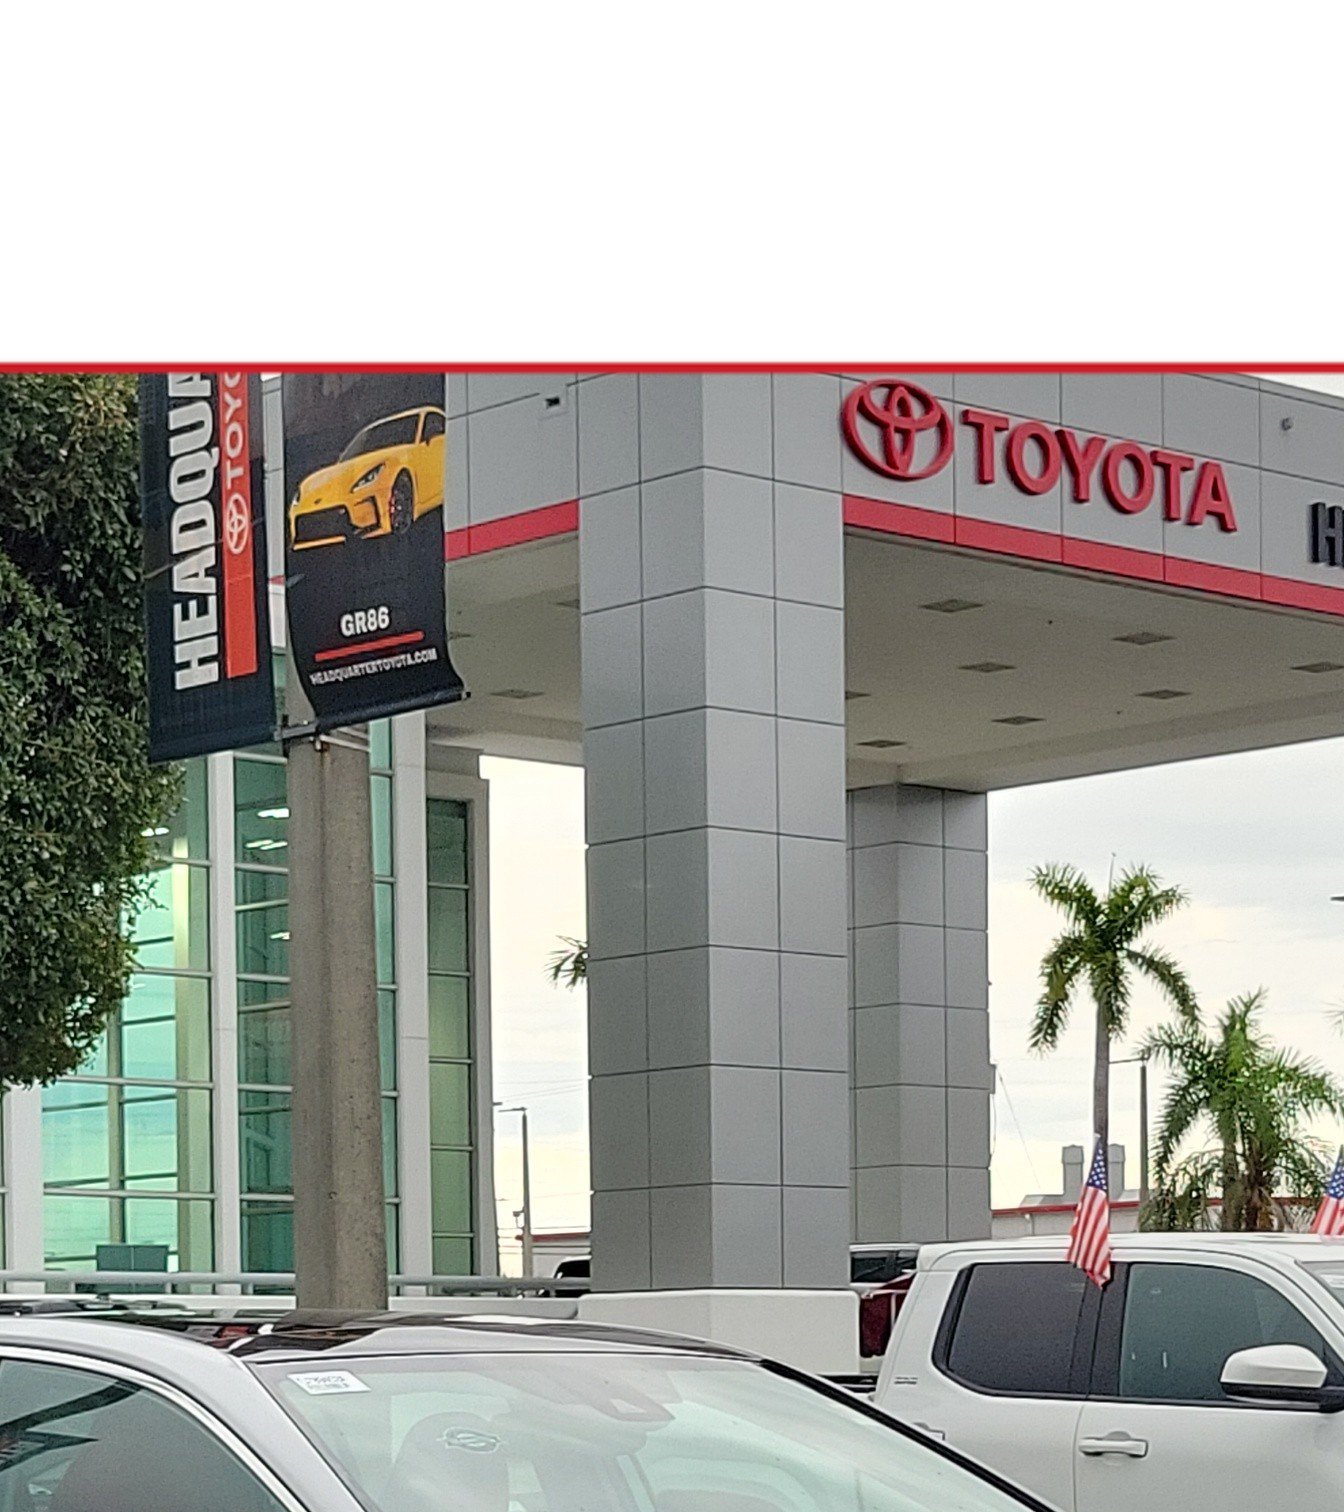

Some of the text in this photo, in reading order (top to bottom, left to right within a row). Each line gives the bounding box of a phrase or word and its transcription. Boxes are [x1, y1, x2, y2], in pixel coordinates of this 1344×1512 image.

[961, 408, 1239, 534] TOYOTA
[340, 605, 390, 638] GR86
[308, 647, 438, 686] HEADQUARTERTOYOTA.COM
